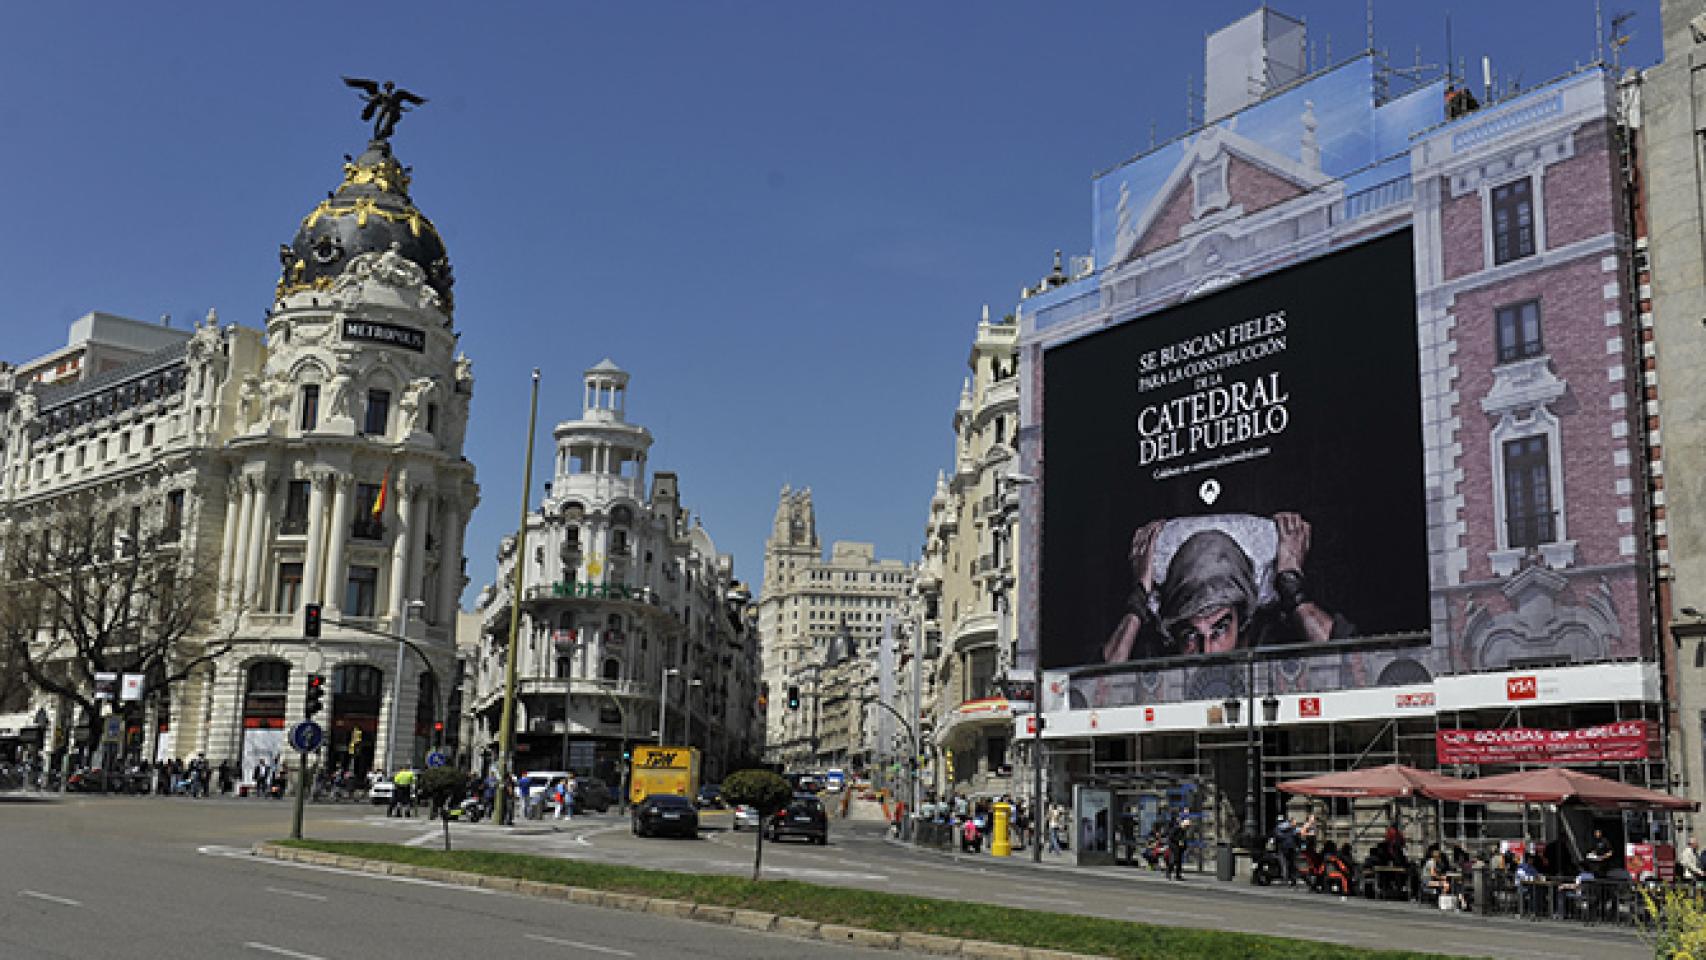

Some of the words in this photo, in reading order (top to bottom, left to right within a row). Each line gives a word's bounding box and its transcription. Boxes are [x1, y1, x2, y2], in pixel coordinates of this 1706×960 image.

[1139, 350, 1158, 373] SE
[1160, 328, 1226, 367] BUSCAN
[1229, 310, 1287, 346] FIELES
[1138, 372, 1290, 437] CATEDRAL
[1139, 432, 1185, 466] DEL
[1189, 404, 1290, 453] PUEBLO
